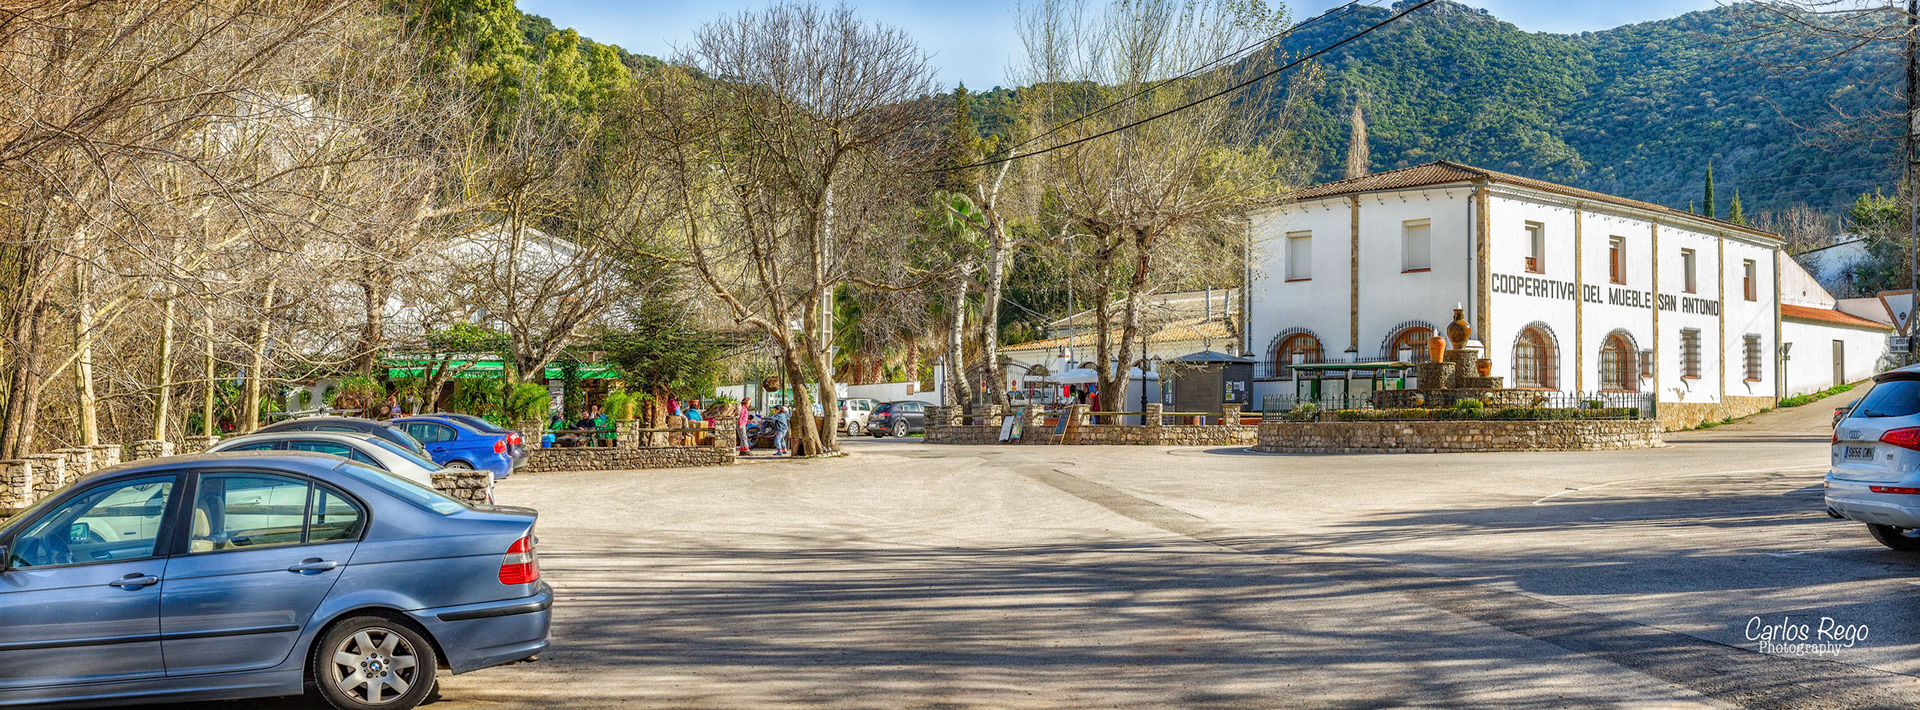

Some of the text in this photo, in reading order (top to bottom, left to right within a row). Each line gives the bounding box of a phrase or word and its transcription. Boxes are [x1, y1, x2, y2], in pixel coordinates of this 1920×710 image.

[1491, 273, 1719, 317] COOPERATIVA DEL MUEBLE SAN ANTONIO
